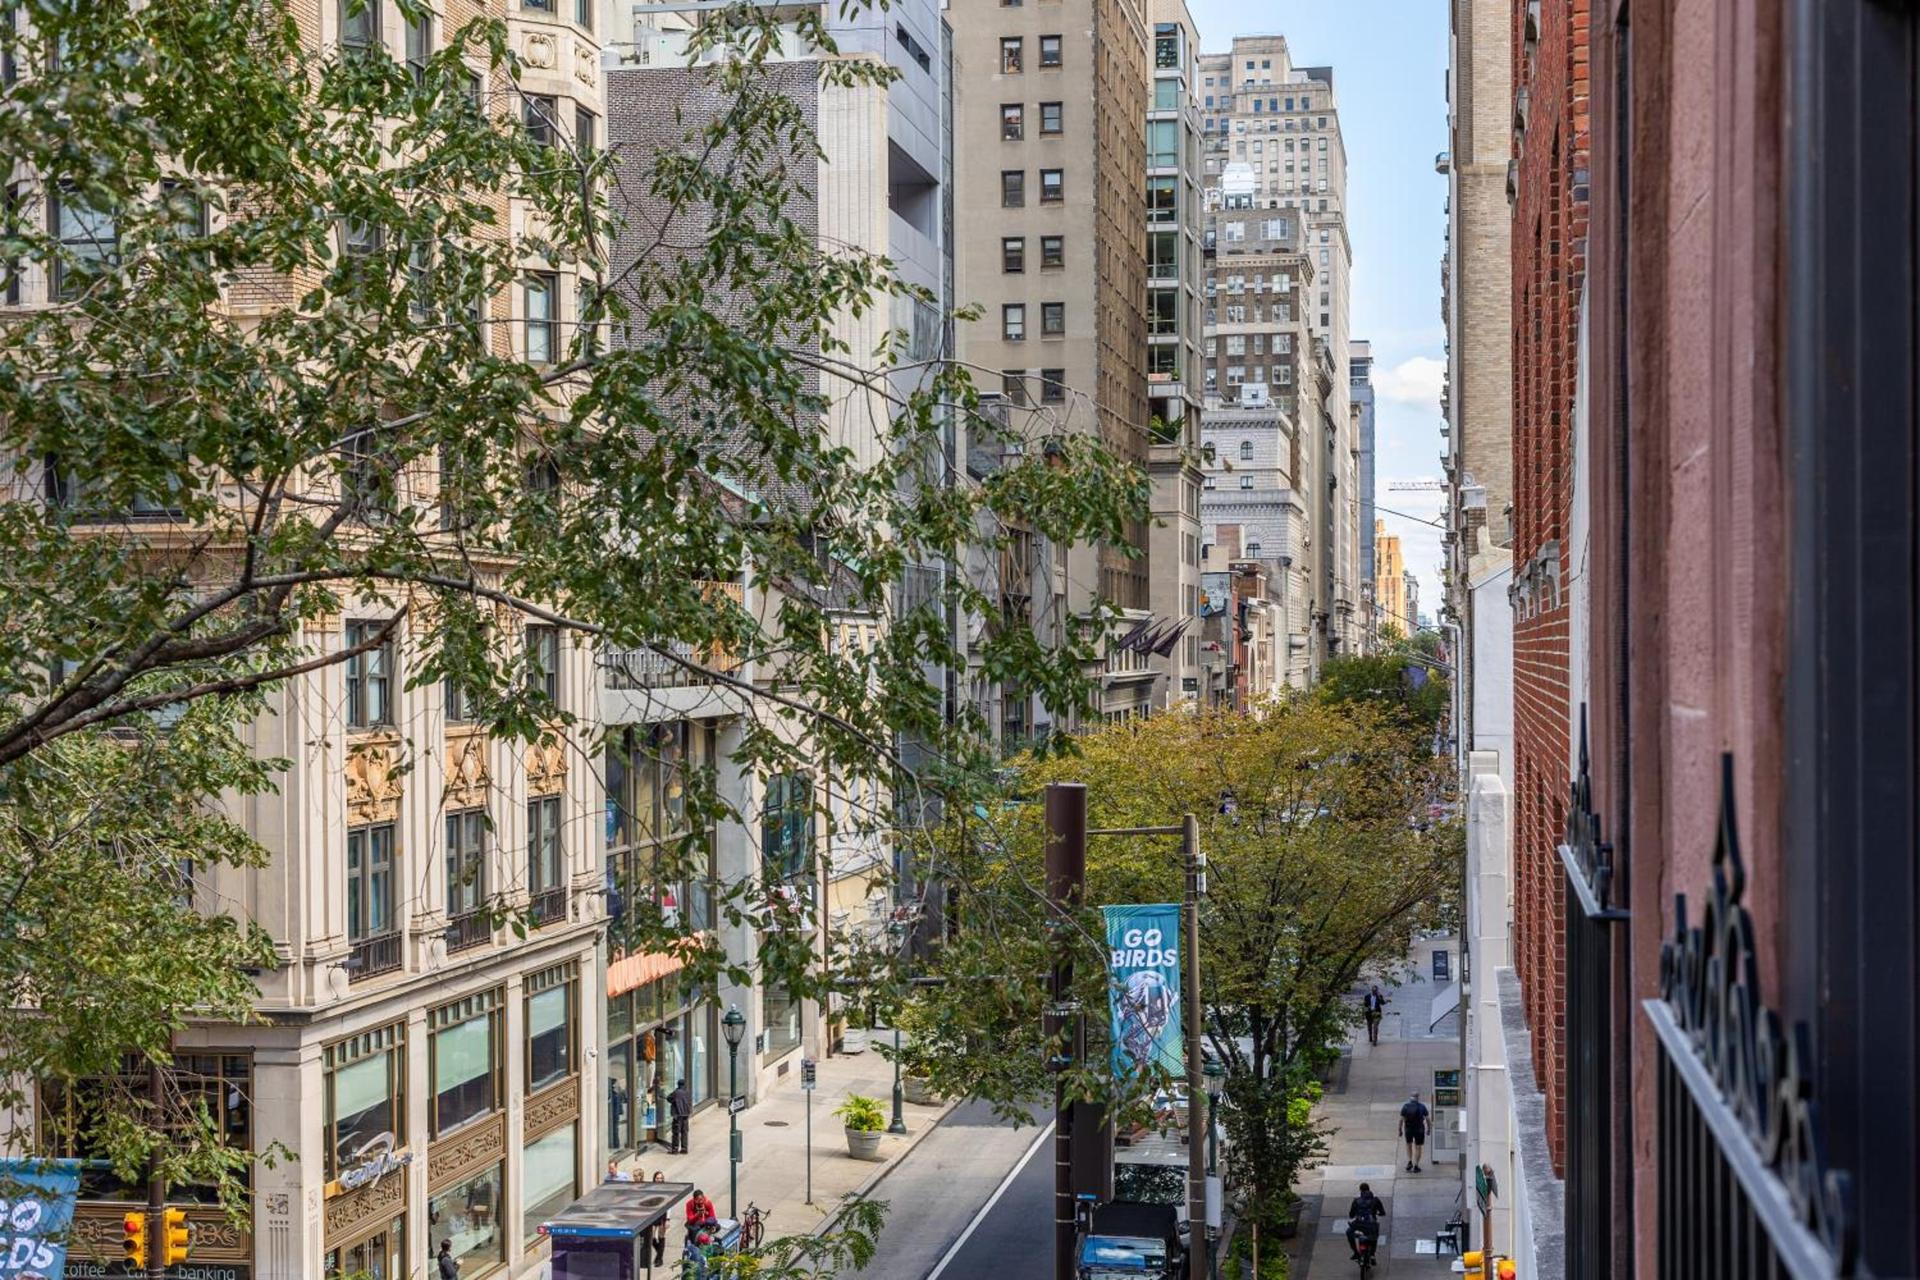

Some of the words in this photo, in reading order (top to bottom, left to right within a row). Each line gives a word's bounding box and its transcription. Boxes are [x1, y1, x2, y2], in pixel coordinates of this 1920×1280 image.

[1124, 928, 1162, 948] GO
[1111, 949, 1177, 967] BIRDS
[178, 1263, 236, 1280] banking
